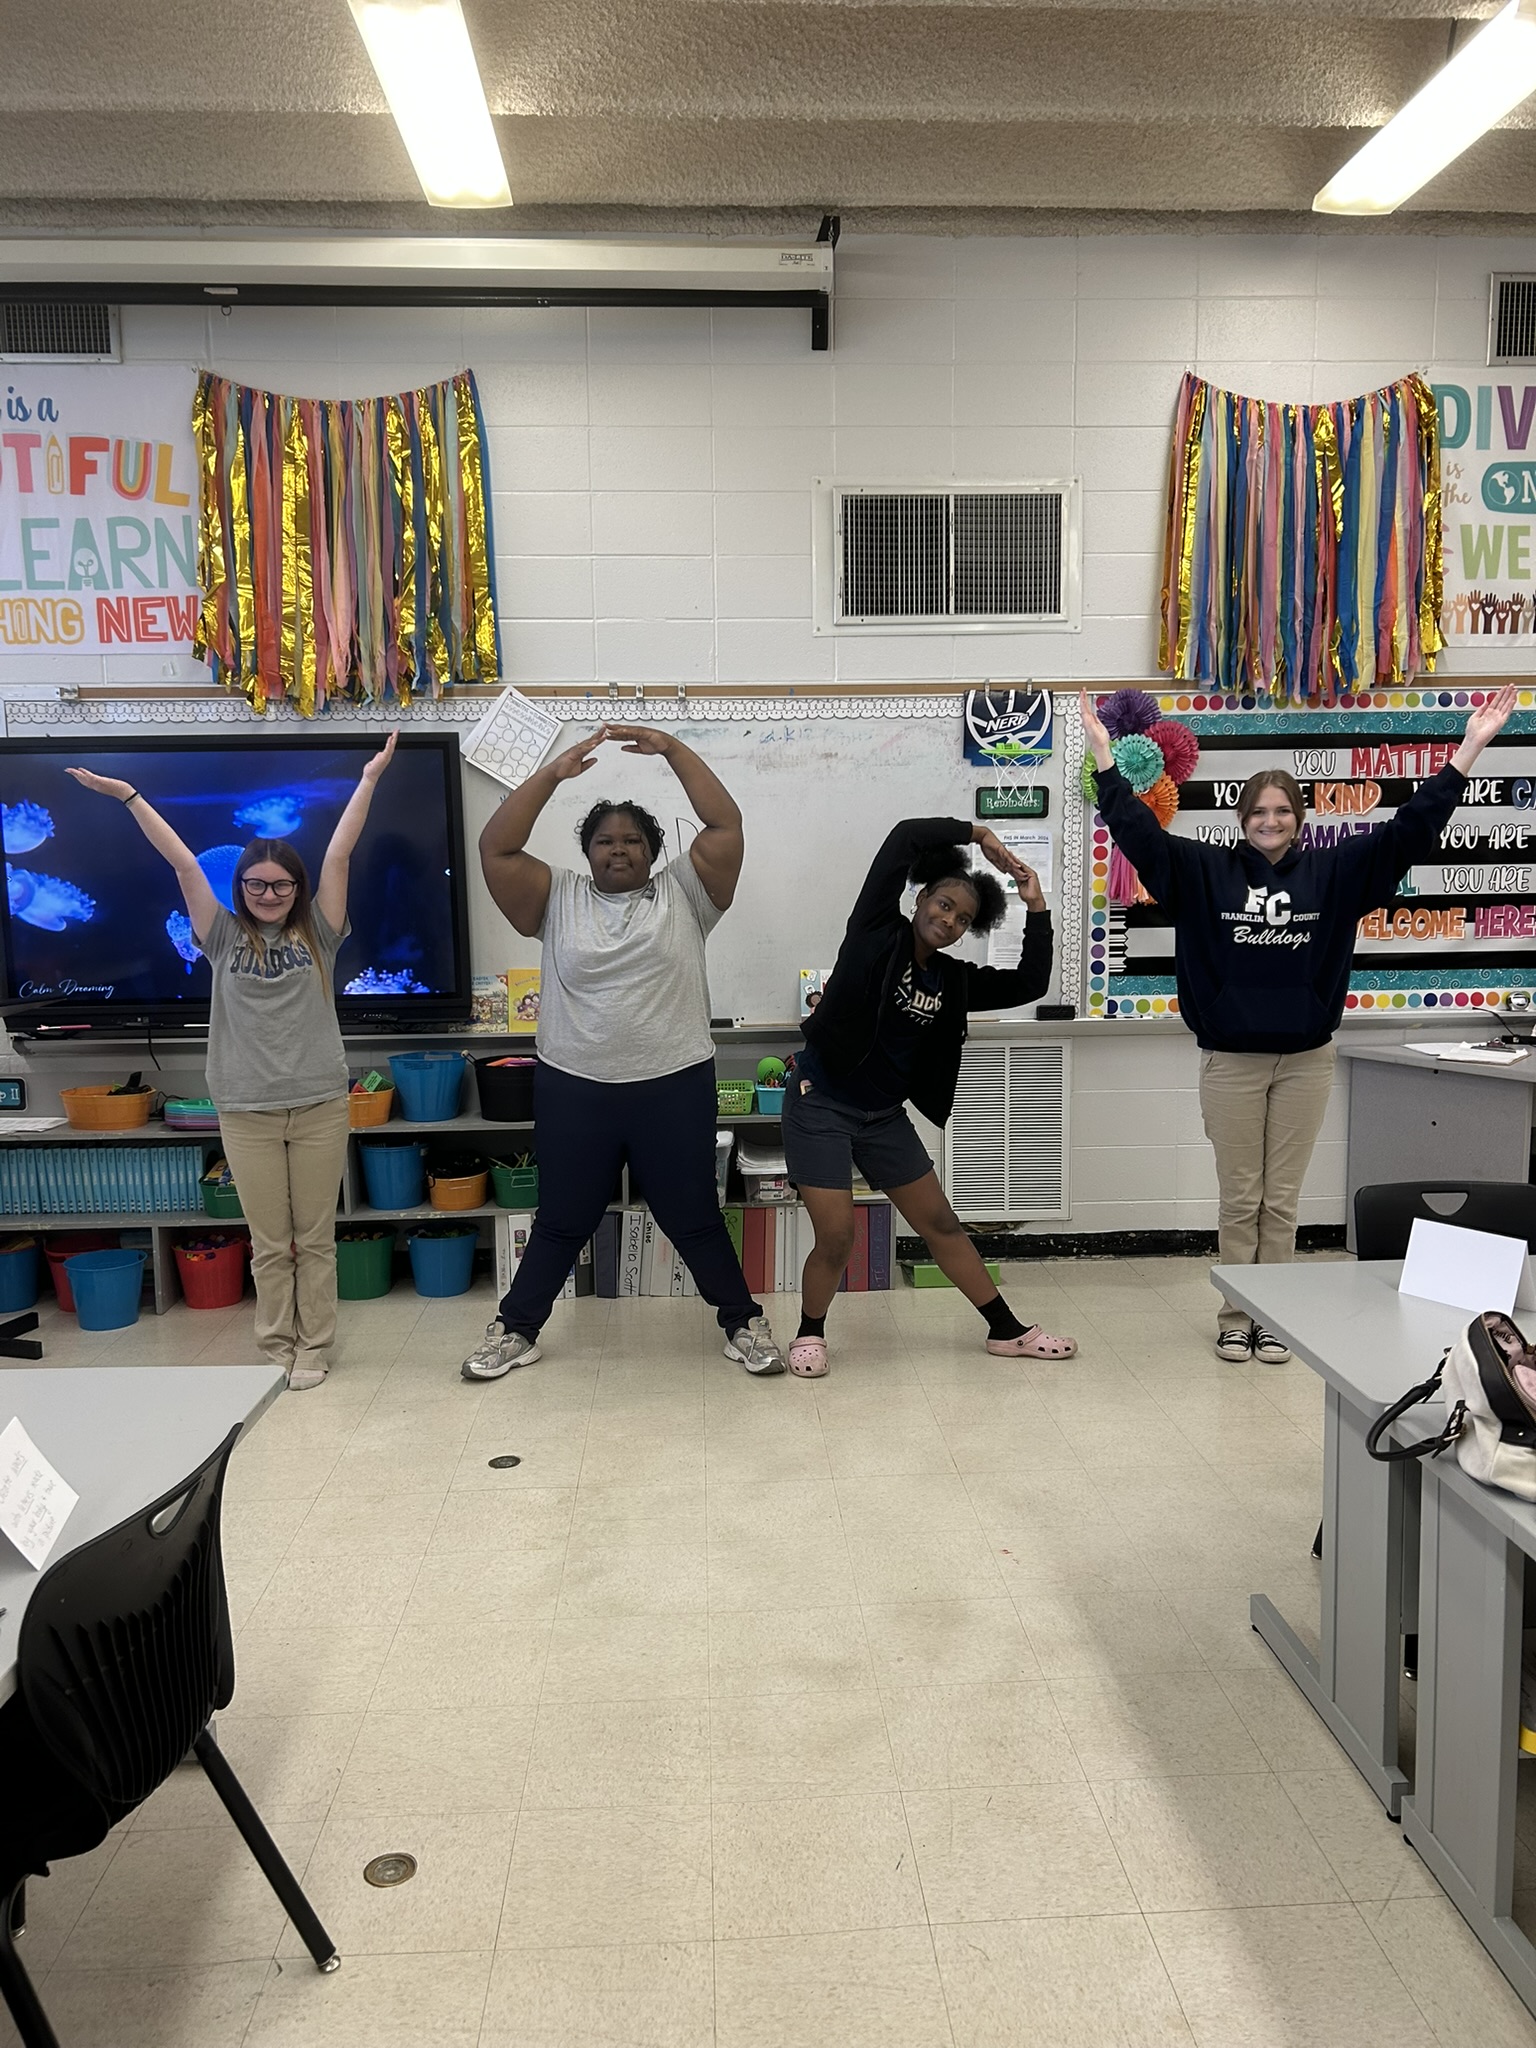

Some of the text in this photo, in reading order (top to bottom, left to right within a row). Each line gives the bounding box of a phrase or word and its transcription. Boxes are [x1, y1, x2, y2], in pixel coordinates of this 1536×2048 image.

[7, 386, 59, 422] is a
[1446, 461, 1465, 483] is
[1442, 482, 1473, 508] the
[1460, 524, 1531, 581] WE
[96, 594, 198, 644] NEW
[985, 714, 1029, 734] NERF
[1293, 750, 1336, 777] YOU
[1314, 780, 1383, 816] KIND
[1462, 778, 1505, 805] ARE
[1440, 822, 1532, 850] YOU ARE
[1442, 866, 1485, 893] YOU
[1488, 865, 1532, 893] ARE
[1221, 912, 1321, 923] FRANKLIN COUNTY
[1244, 884, 1292, 926] FC
[1356, 903, 1536, 941] ELCOME HERE
[1233, 925, 1312, 951] Bulldogs
[19, 978, 116, 999] Calm Dreaming
[623, 1214, 642, 1295] Isabella Scott
